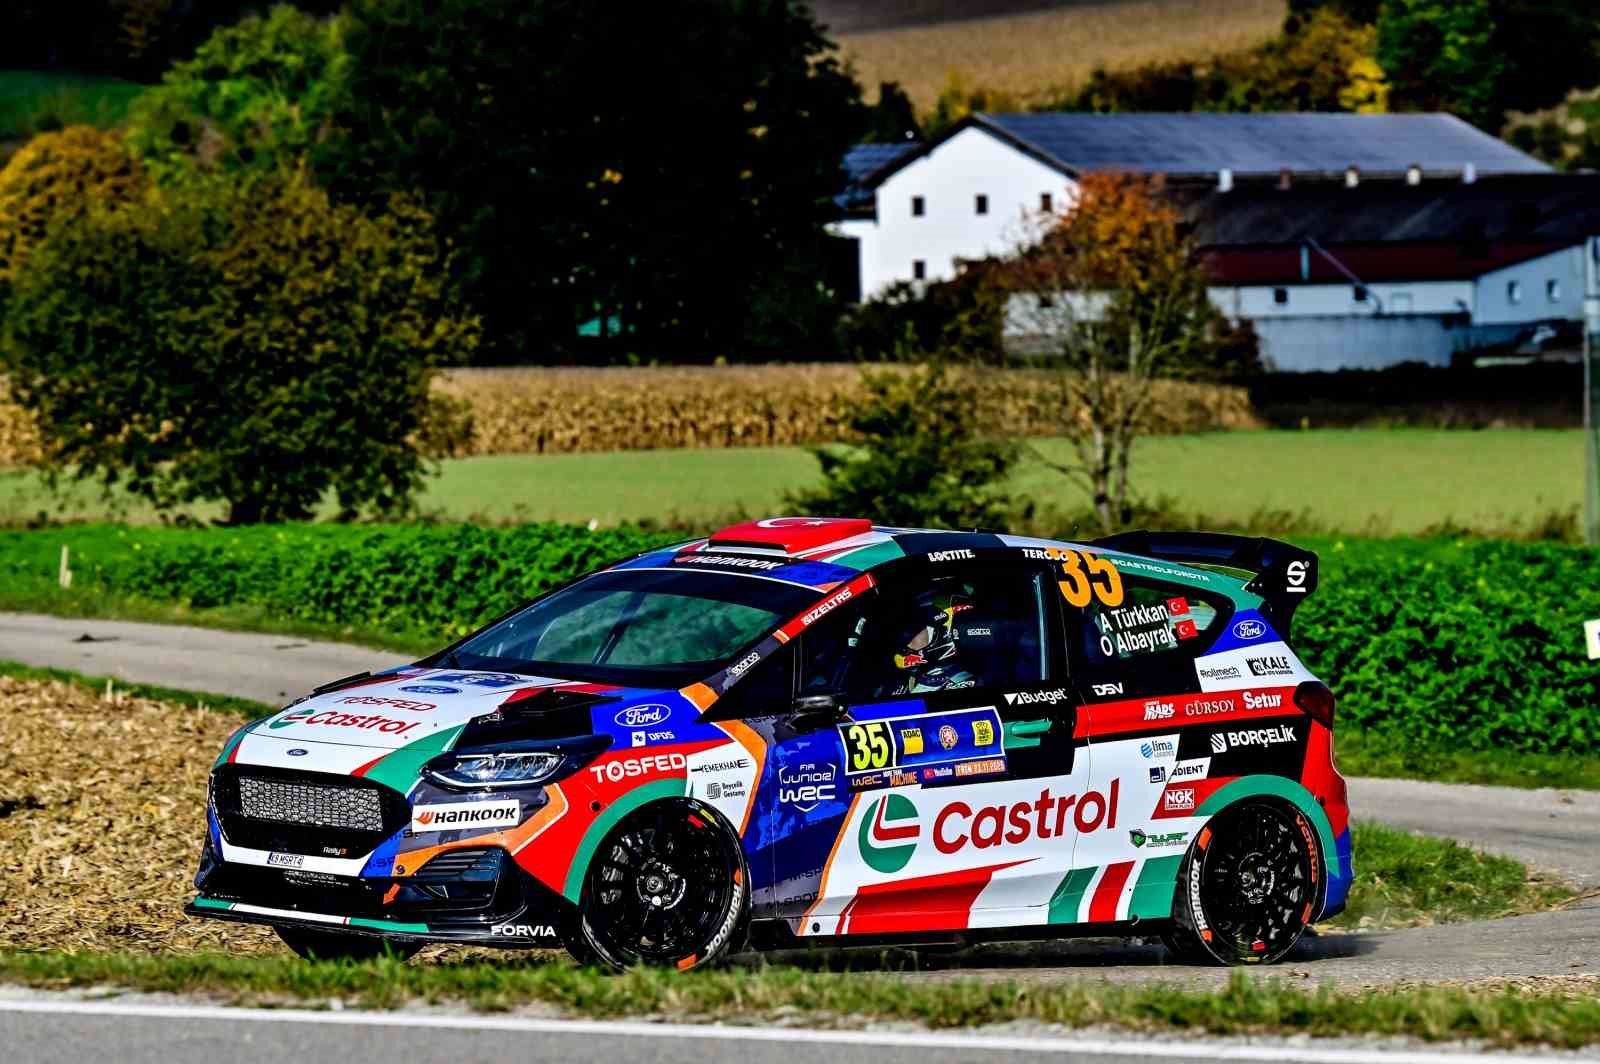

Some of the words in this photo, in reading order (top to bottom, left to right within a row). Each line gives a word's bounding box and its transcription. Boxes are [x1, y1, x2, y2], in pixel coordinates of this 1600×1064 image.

[928, 549, 975, 562] LOCTITE
[1045, 547, 1124, 608] 35
[1100, 612, 1113, 633] A
[1111, 603, 1169, 630] Türkkan
[1100, 635, 1114, 657] O
[1117, 623, 1177, 653] Albayrak
[1260, 656, 1291, 670] KALE
[1020, 688, 1067, 704] Budget
[1092, 682, 1124, 696] DSV
[1185, 698, 1235, 716] GÜRSOY
[1243, 691, 1281, 709] Setur
[306, 711, 422, 735] Castrol
[625, 707, 662, 725] Ford
[647, 731, 675, 742] DFDS
[1227, 724, 1297, 748] BORÇELİK
[849, 723, 889, 770] 35
[1152, 740, 1173, 752] lima
[590, 753, 686, 784] TOSFED
[780, 785, 836, 803] WRC
[1167, 790, 1192, 804] NGK
[932, 777, 1120, 855] Castrol
[491, 925, 556, 937] FORVIA
